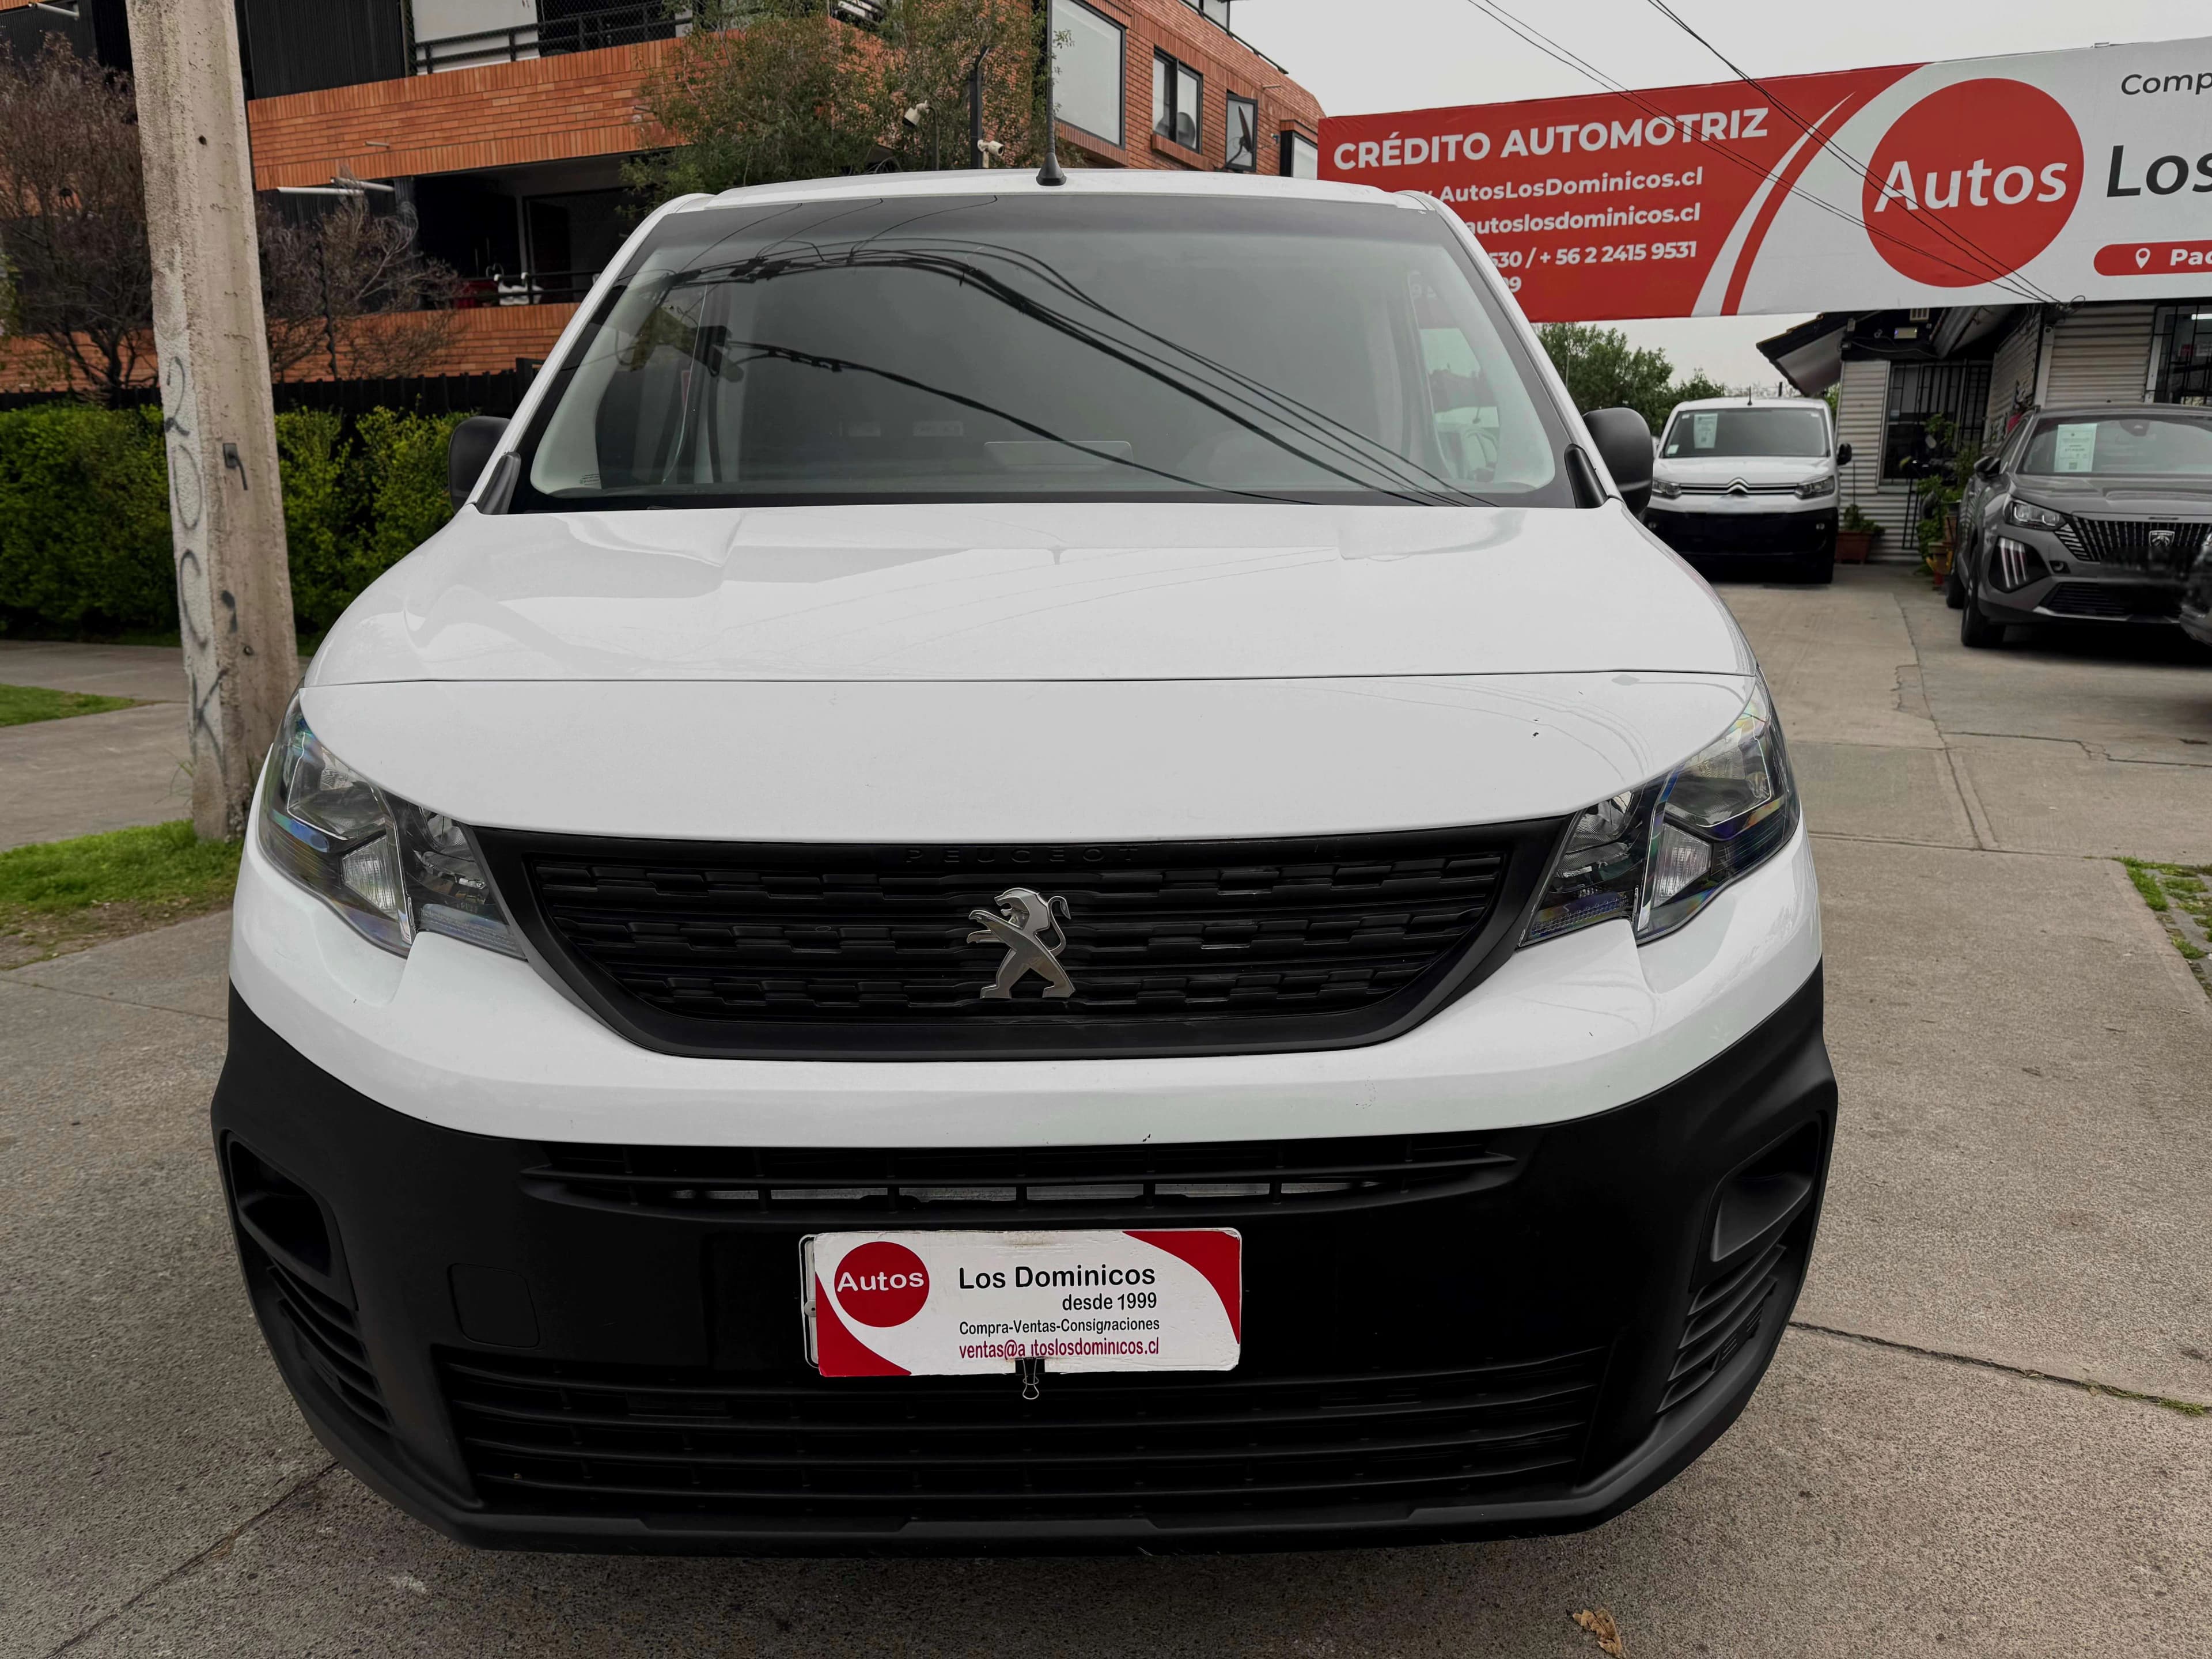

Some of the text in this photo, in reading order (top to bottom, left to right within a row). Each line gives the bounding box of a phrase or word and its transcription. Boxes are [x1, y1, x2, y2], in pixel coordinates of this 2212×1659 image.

[2121, 73, 2212, 95] Comp
[1333, 107, 1769, 170] CRÉDITO AUTOMOTRIZ
[1422, 166, 1703, 202] AutosLosDominicos.cl
[1874, 145, 2212, 213] Autos Los
[1525, 247, 1537, 268] /
[1540, 252, 1551, 263] +
[1555, 248, 1581, 266] 56
[1584, 247, 1597, 263] 2
[1601, 244, 1647, 262] 2415
[1651, 240, 1697, 260] 9531
[905, 847, 1138, 863] PEUGEOT
[837, 1264, 1156, 1292] Autos Los Dominicos
[1062, 1292, 1157, 1311] desde 1999
[959, 1317, 1160, 1338] Compra-Ventas-Consignaciones
